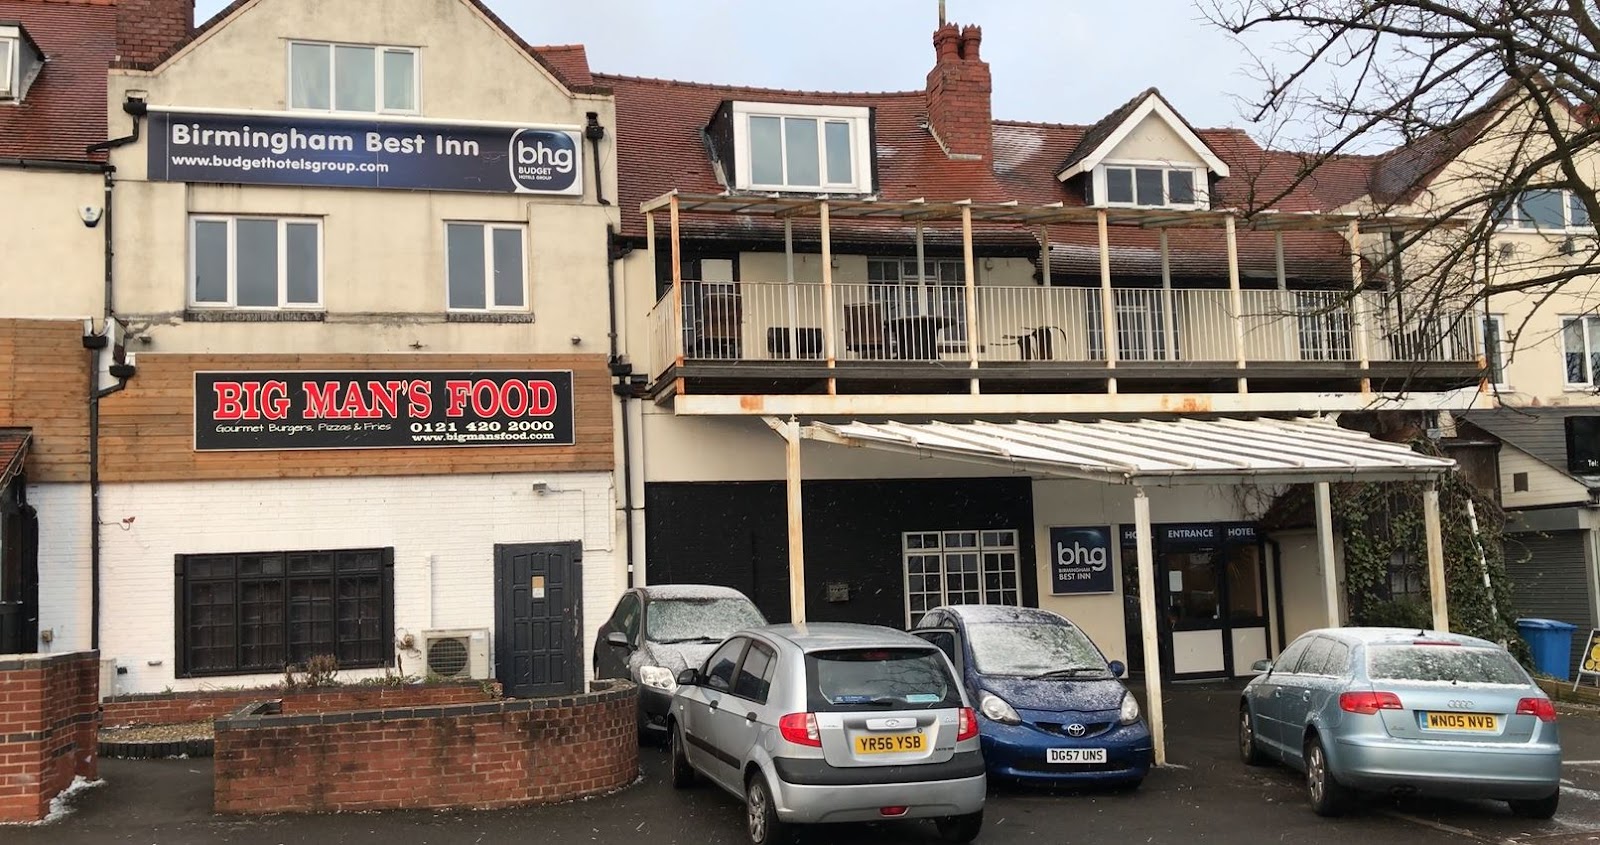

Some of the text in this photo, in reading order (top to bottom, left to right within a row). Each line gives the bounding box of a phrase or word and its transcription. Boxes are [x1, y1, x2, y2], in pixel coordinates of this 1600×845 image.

[172, 123, 480, 157] Birmingham Best Inn
[517, 140, 573, 174] bhg
[171, 155, 389, 174] www.budgethotelsgroup.com
[518, 166, 552, 175] BUDGET
[213, 378, 558, 421] BIG MAN'S FOOD
[215, 421, 392, 436] Gourmet Burgers, Pizzas & Fries
[410, 421, 554, 433] 0121 420 2000
[411, 431, 555, 443] www.bigmansfood.com
[1587, 459, 1599, 467] Tel:
[1167, 529, 1214, 538] ENTRANCE
[1227, 527, 1256, 537] HOTEL
[1057, 541, 1107, 572] bhg
[1058, 572, 1091, 581] BEST INN
[1429, 714, 1494, 729] WN05 NVB
[860, 735, 921, 751] YR56 YSB
[1051, 749, 1103, 761] DG57 UNS
